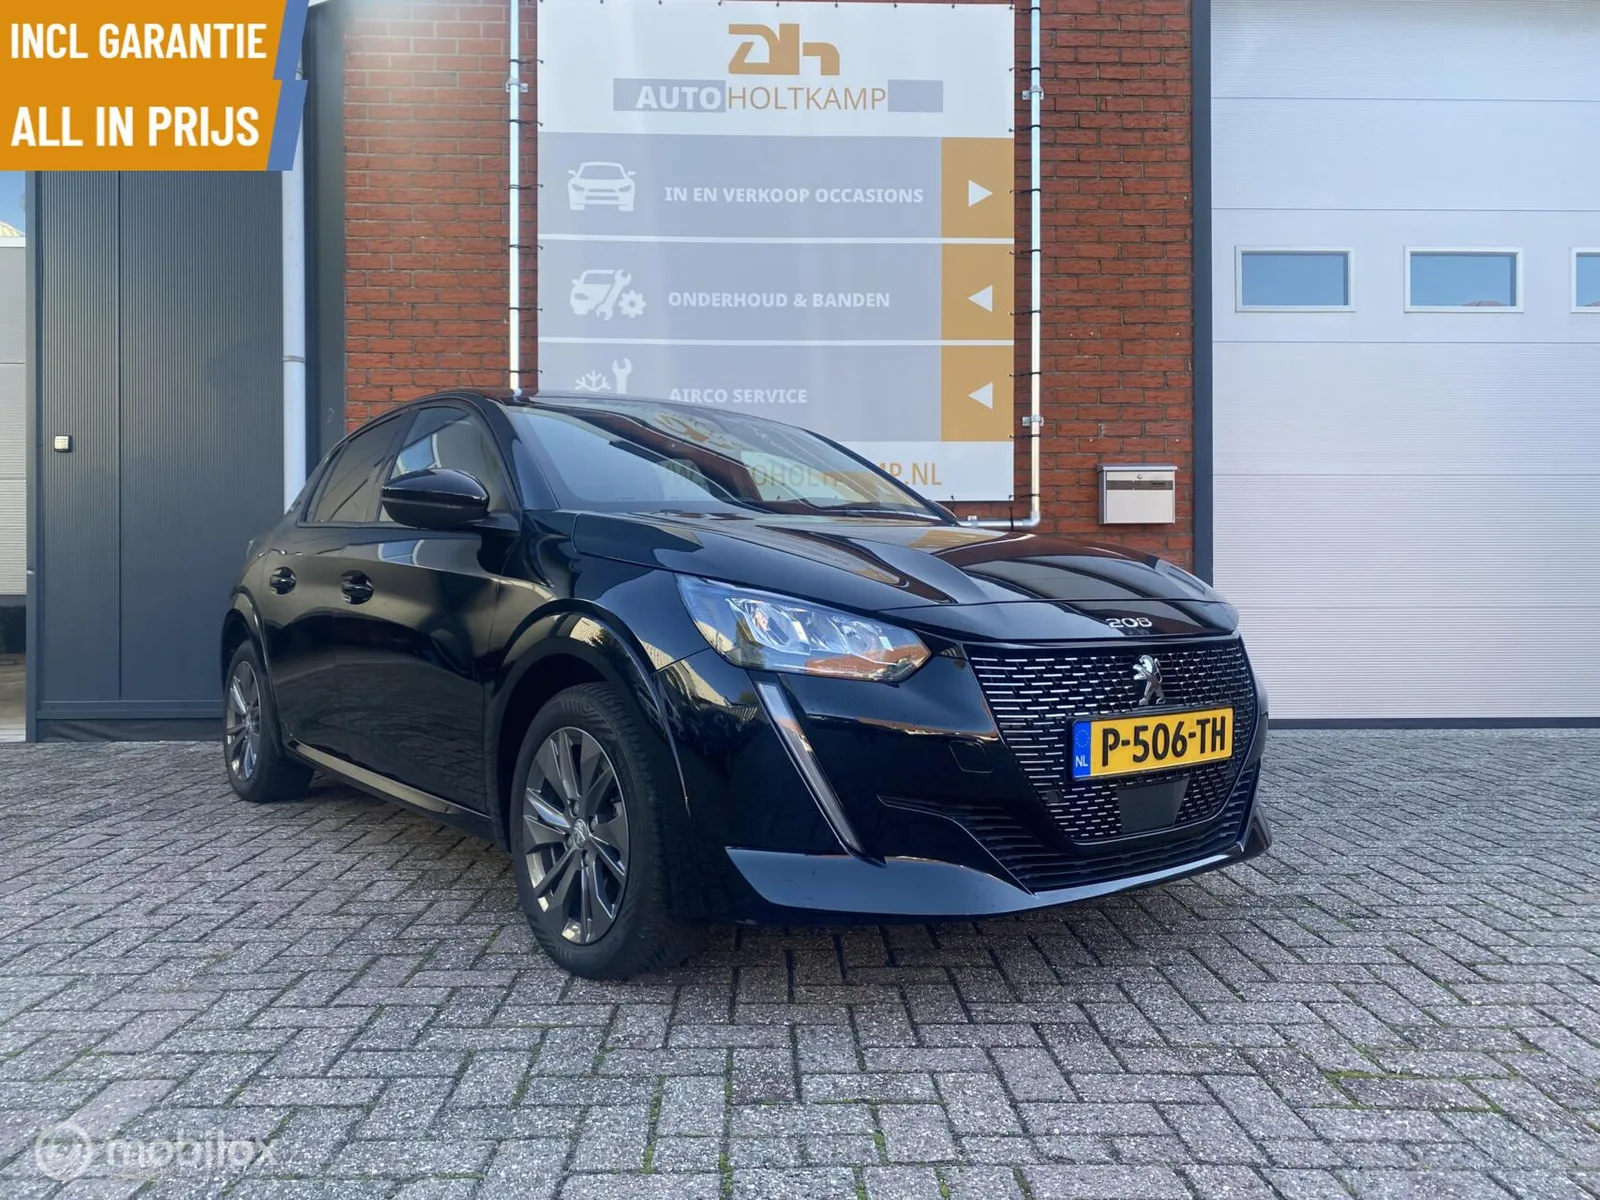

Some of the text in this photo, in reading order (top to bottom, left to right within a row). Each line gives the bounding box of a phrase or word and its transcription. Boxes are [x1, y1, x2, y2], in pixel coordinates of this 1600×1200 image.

[664, 186, 924, 205] IN EN VERKOOP OCCASIONS
[667, 291, 891, 309] ONDERHOUD & BANDEN
[668, 387, 808, 404] AIRCO SERVICE
[1106, 616, 1153, 629] 208
[1074, 715, 1227, 768] NL P-506-TH
